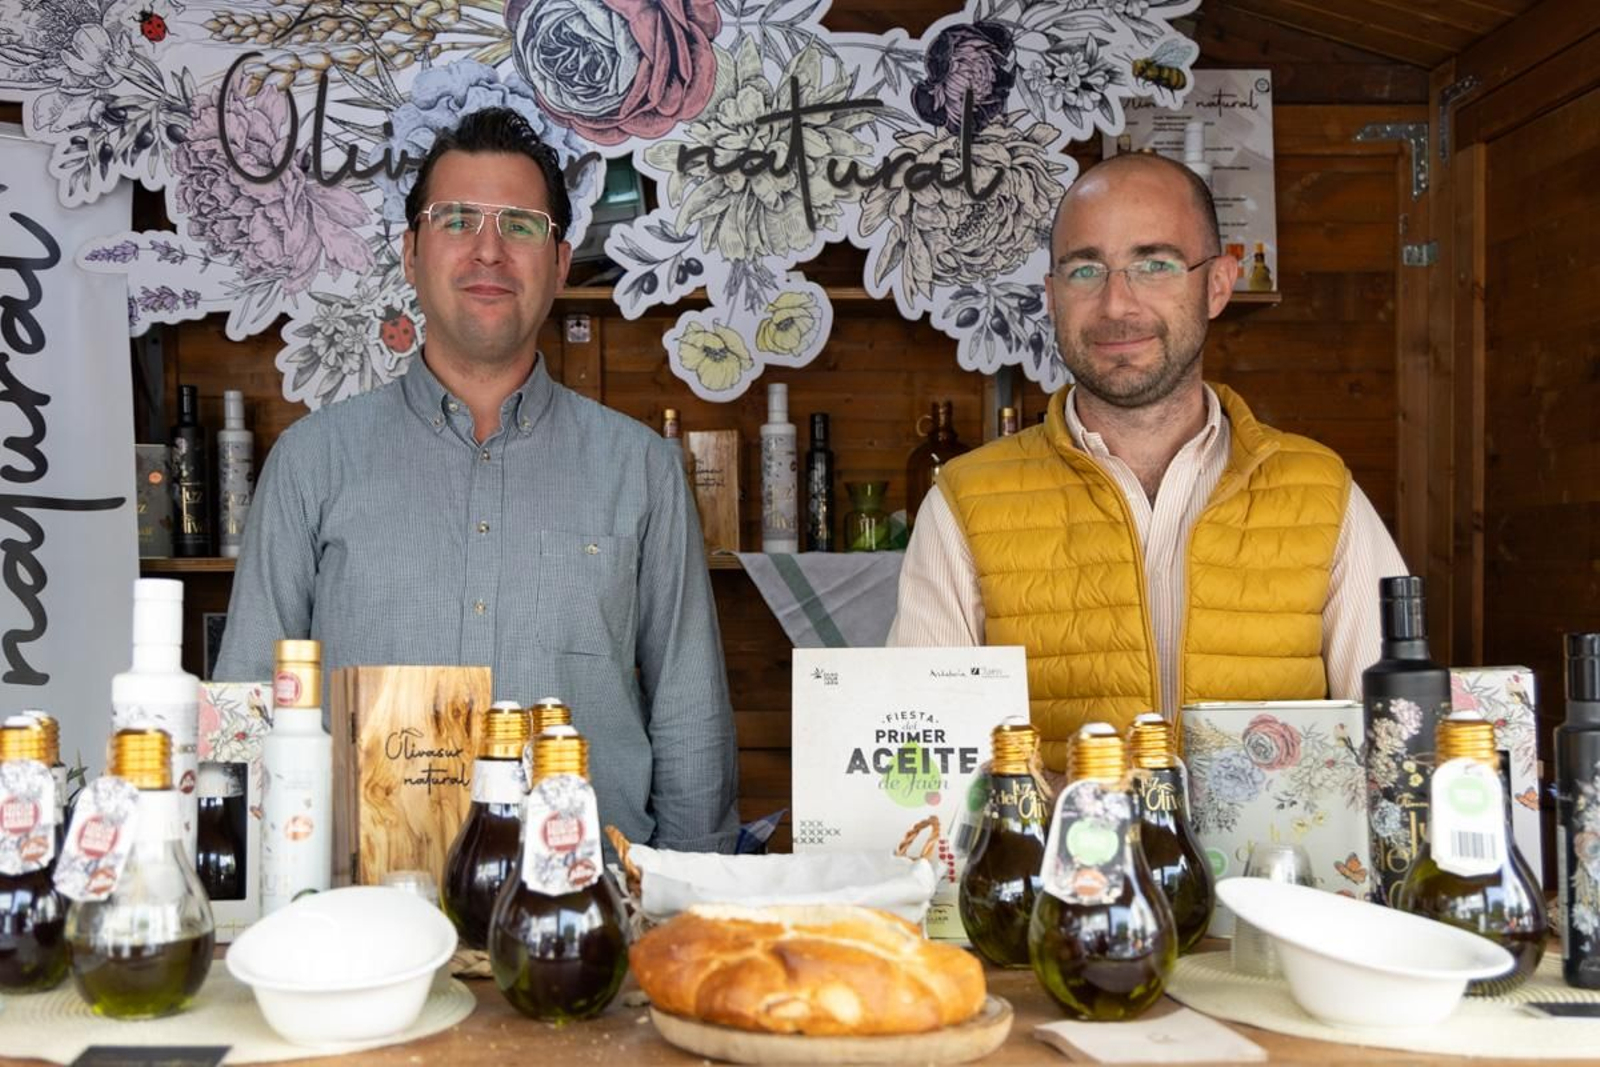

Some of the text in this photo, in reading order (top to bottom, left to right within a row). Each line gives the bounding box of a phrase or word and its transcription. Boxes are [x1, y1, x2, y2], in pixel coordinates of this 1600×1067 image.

[218, 51, 1004, 232] Olivr natural
[885, 710, 935, 724] FIESTA
[901, 721, 918, 731] del
[385, 729, 464, 760] Olivasur
[875, 729, 946, 743] PRIMER
[845, 747, 979, 774] ACEITE
[403, 762, 471, 796] natural
[878, 768, 901, 790] de
[1146, 783, 1182, 811] Oliv
